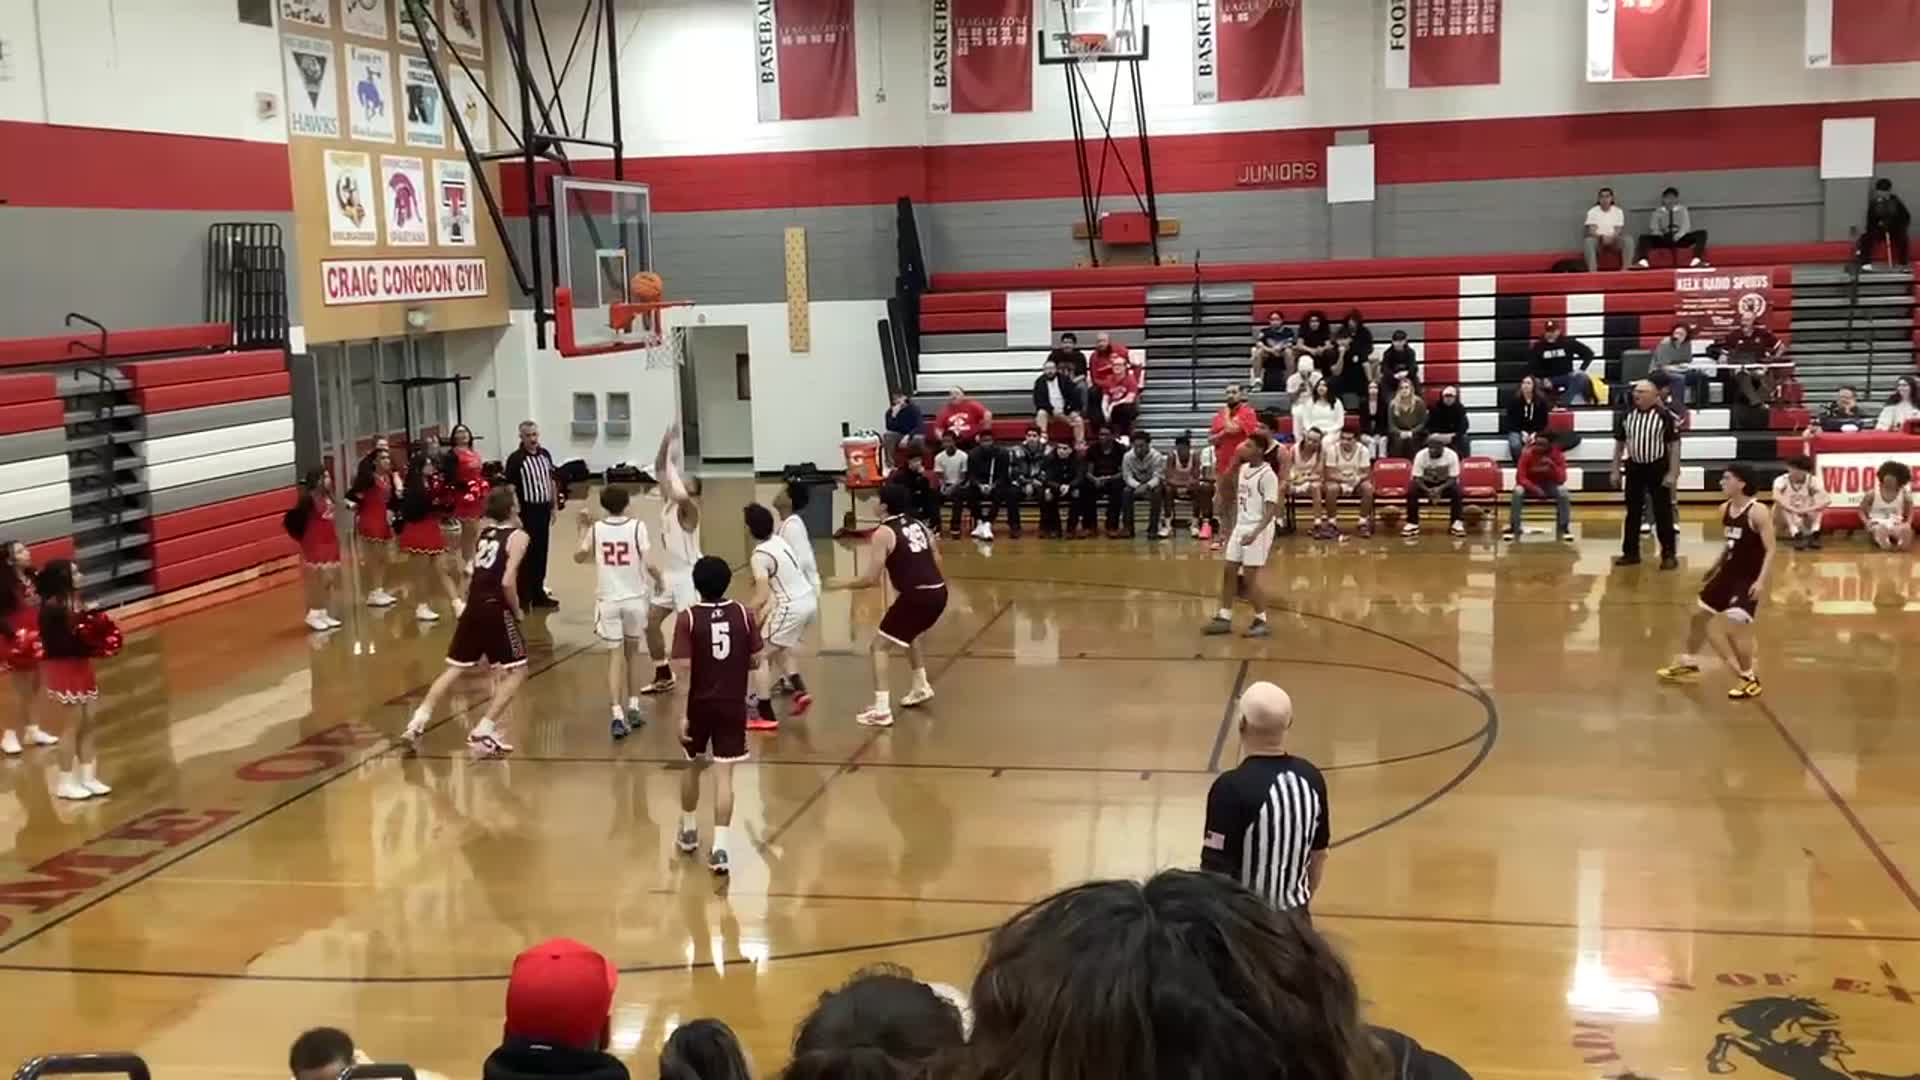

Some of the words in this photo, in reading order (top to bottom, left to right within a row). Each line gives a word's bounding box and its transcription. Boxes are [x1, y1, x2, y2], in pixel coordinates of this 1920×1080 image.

[1238, 163, 1318, 183] JUNIORS
[327, 266, 378, 299] CRAIG
[383, 263, 452, 295] CONGDON
[455, 263, 485, 291] GYM
[1732, 275, 1768, 289] SPORTS
[602, 541, 632, 566] 22
[711, 621, 731, 661] 5
